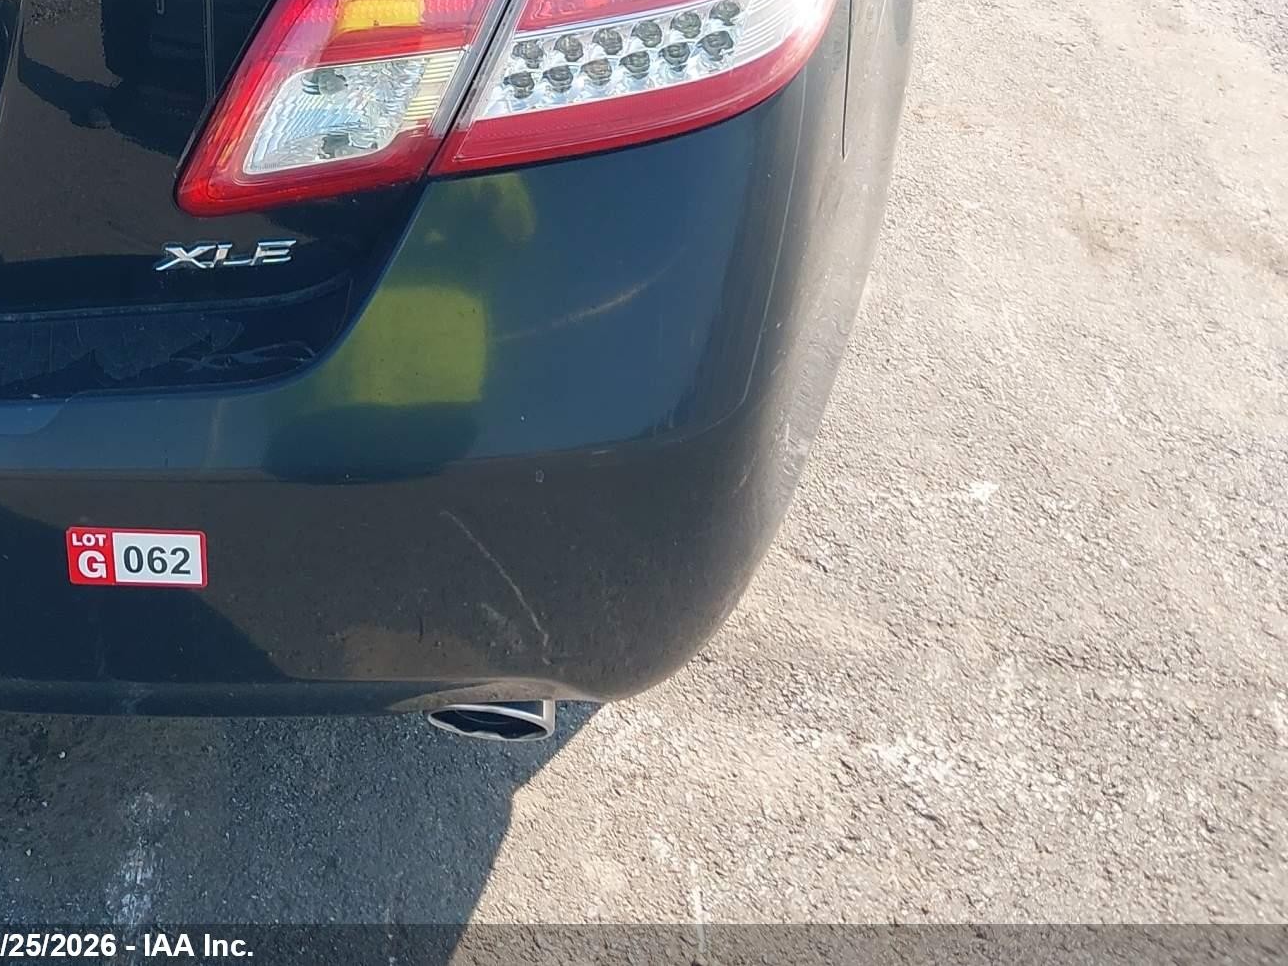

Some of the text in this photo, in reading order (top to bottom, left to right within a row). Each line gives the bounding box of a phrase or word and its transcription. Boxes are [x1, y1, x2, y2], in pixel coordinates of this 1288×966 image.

[156, 240, 296, 270] XLE
[71, 533, 107, 547] LOT
[78, 545, 191, 579] G 062
